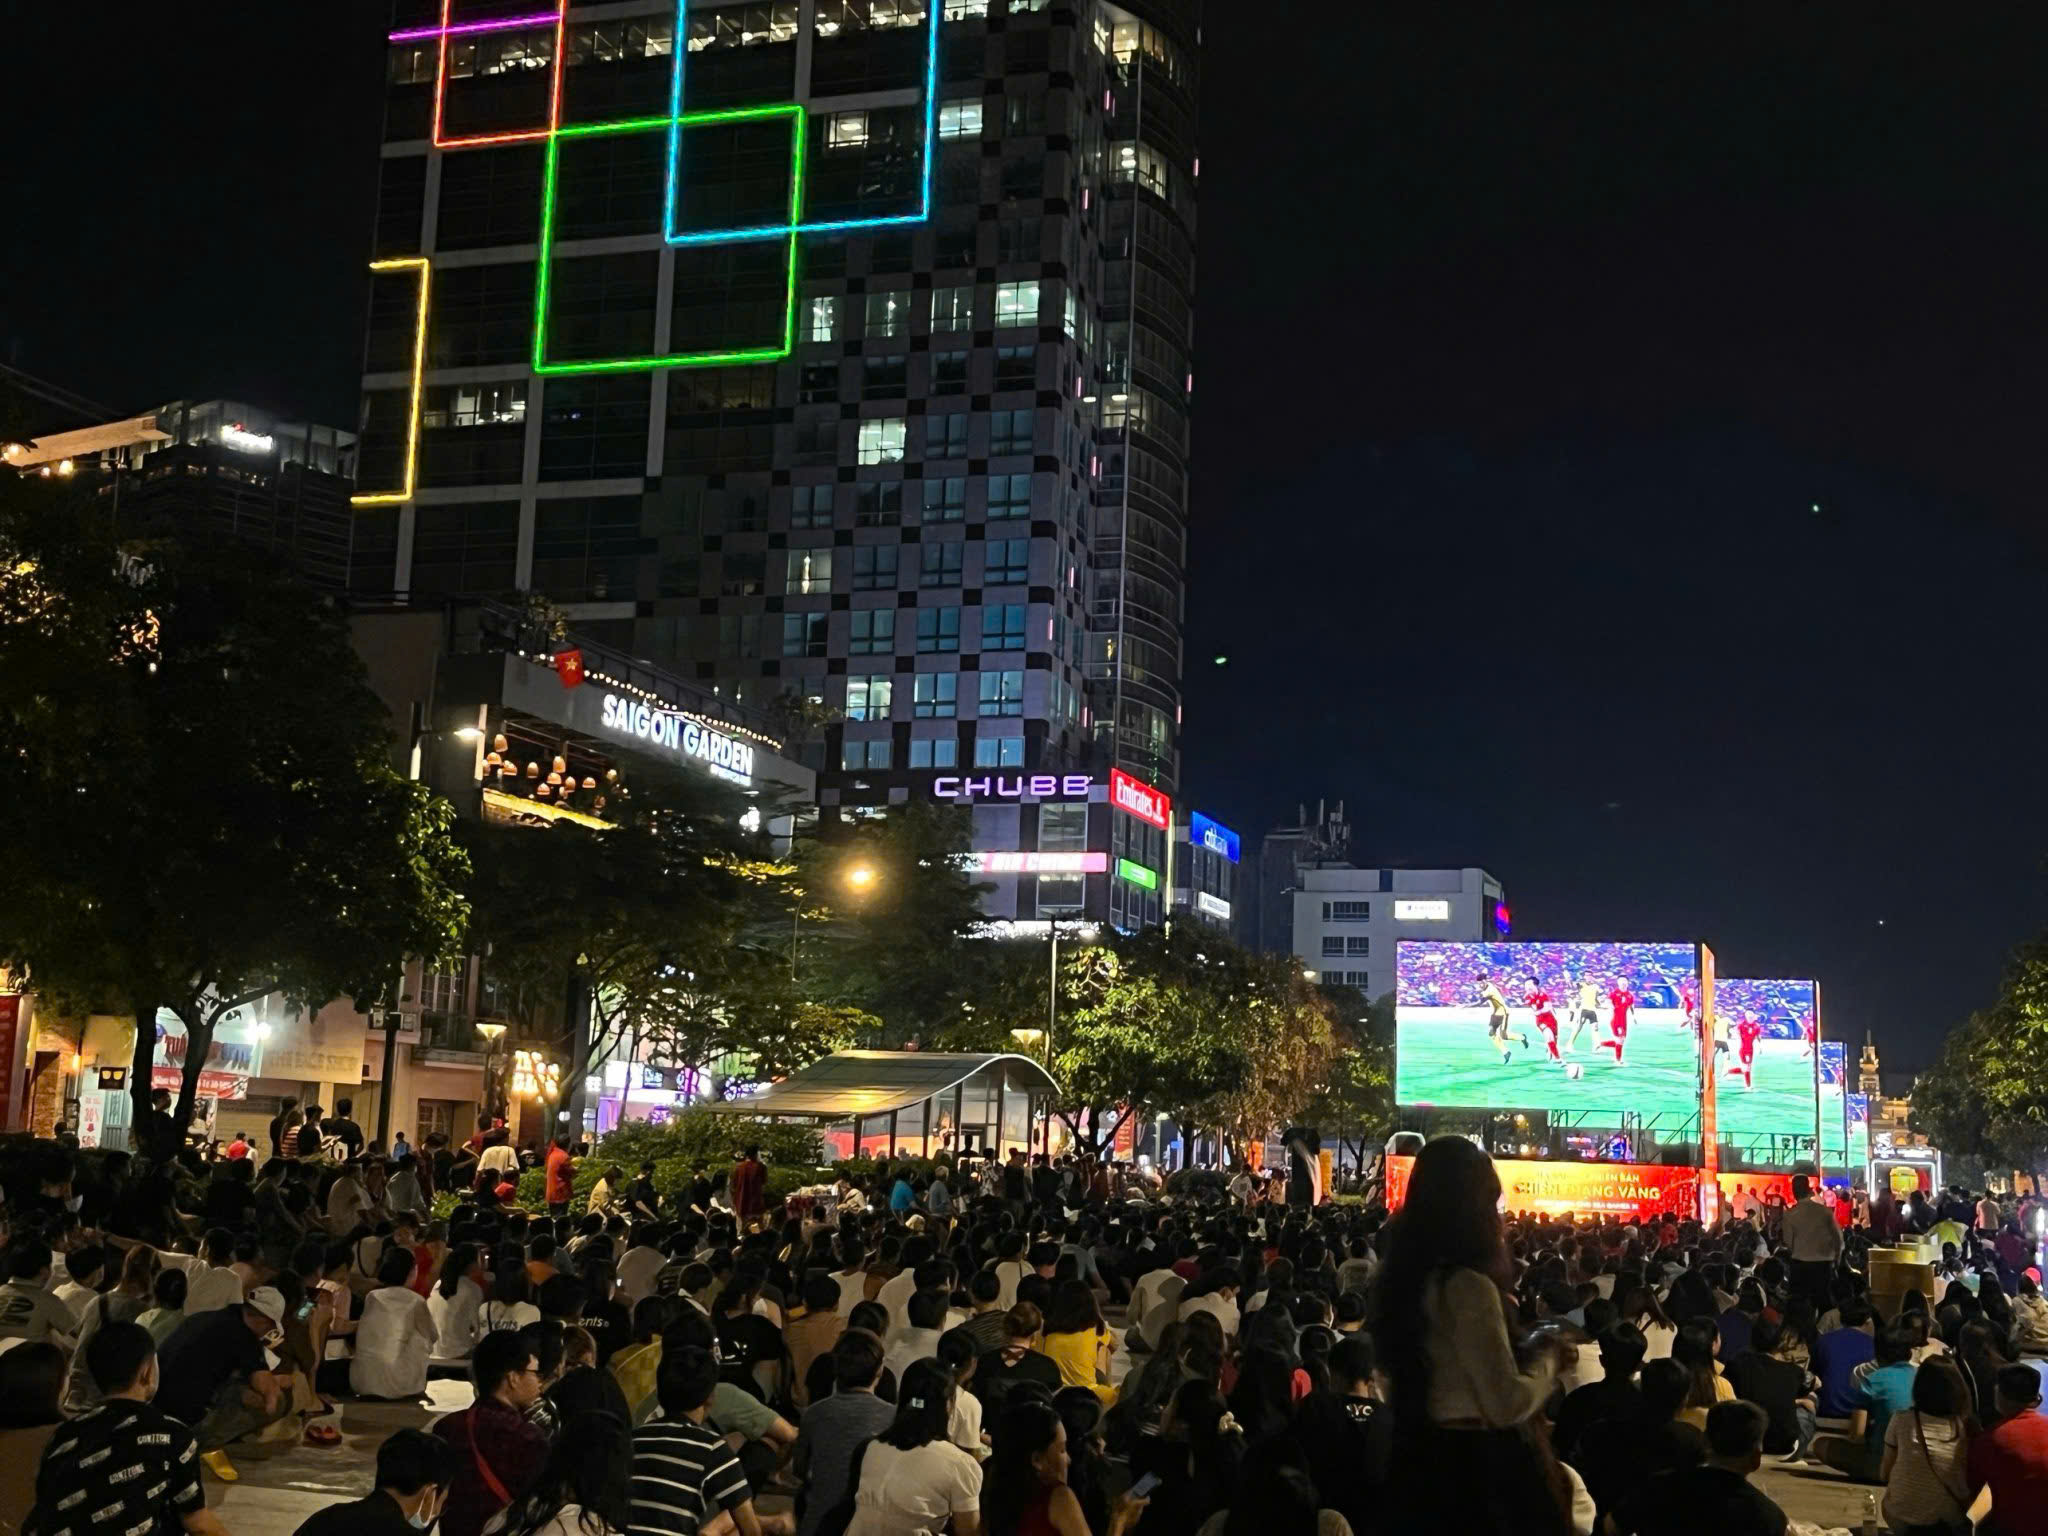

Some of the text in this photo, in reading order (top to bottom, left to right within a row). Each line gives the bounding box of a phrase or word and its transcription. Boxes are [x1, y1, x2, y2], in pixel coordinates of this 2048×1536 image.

[601, 693, 680, 750] SAIGON
[683, 723, 753, 776] GARDEN
[934, 775, 1090, 797] CHUBB
[1116, 776, 1153, 818] Emirates
[1617, 1183, 1661, 1200] VÀNG
